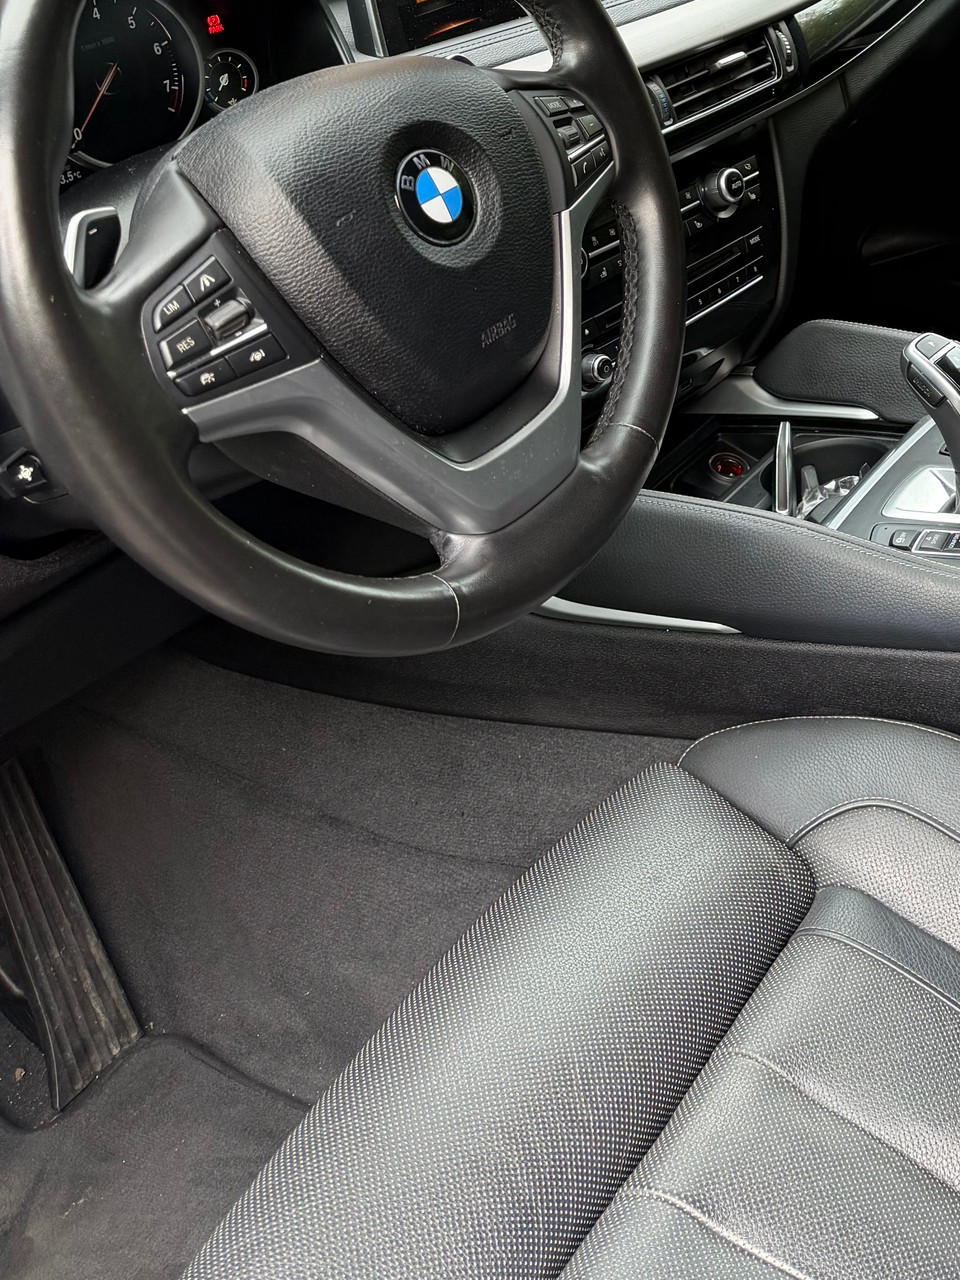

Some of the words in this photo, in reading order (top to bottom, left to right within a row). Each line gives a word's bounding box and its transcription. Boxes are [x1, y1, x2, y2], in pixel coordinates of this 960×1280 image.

[92, 7, 100, 20] 4
[127, 16, 136, 29] 5
[153, 42, 162, 55] 6
[163, 80, 171, 93] 7
[73, 127, 83, 141] 0
[401, 153, 454, 191] BMW
[750, 234, 761, 245] MODE
[163, 300, 180, 315] LIM
[482, 313, 517, 348] AIRBAG
[176, 336, 195, 353] RES
